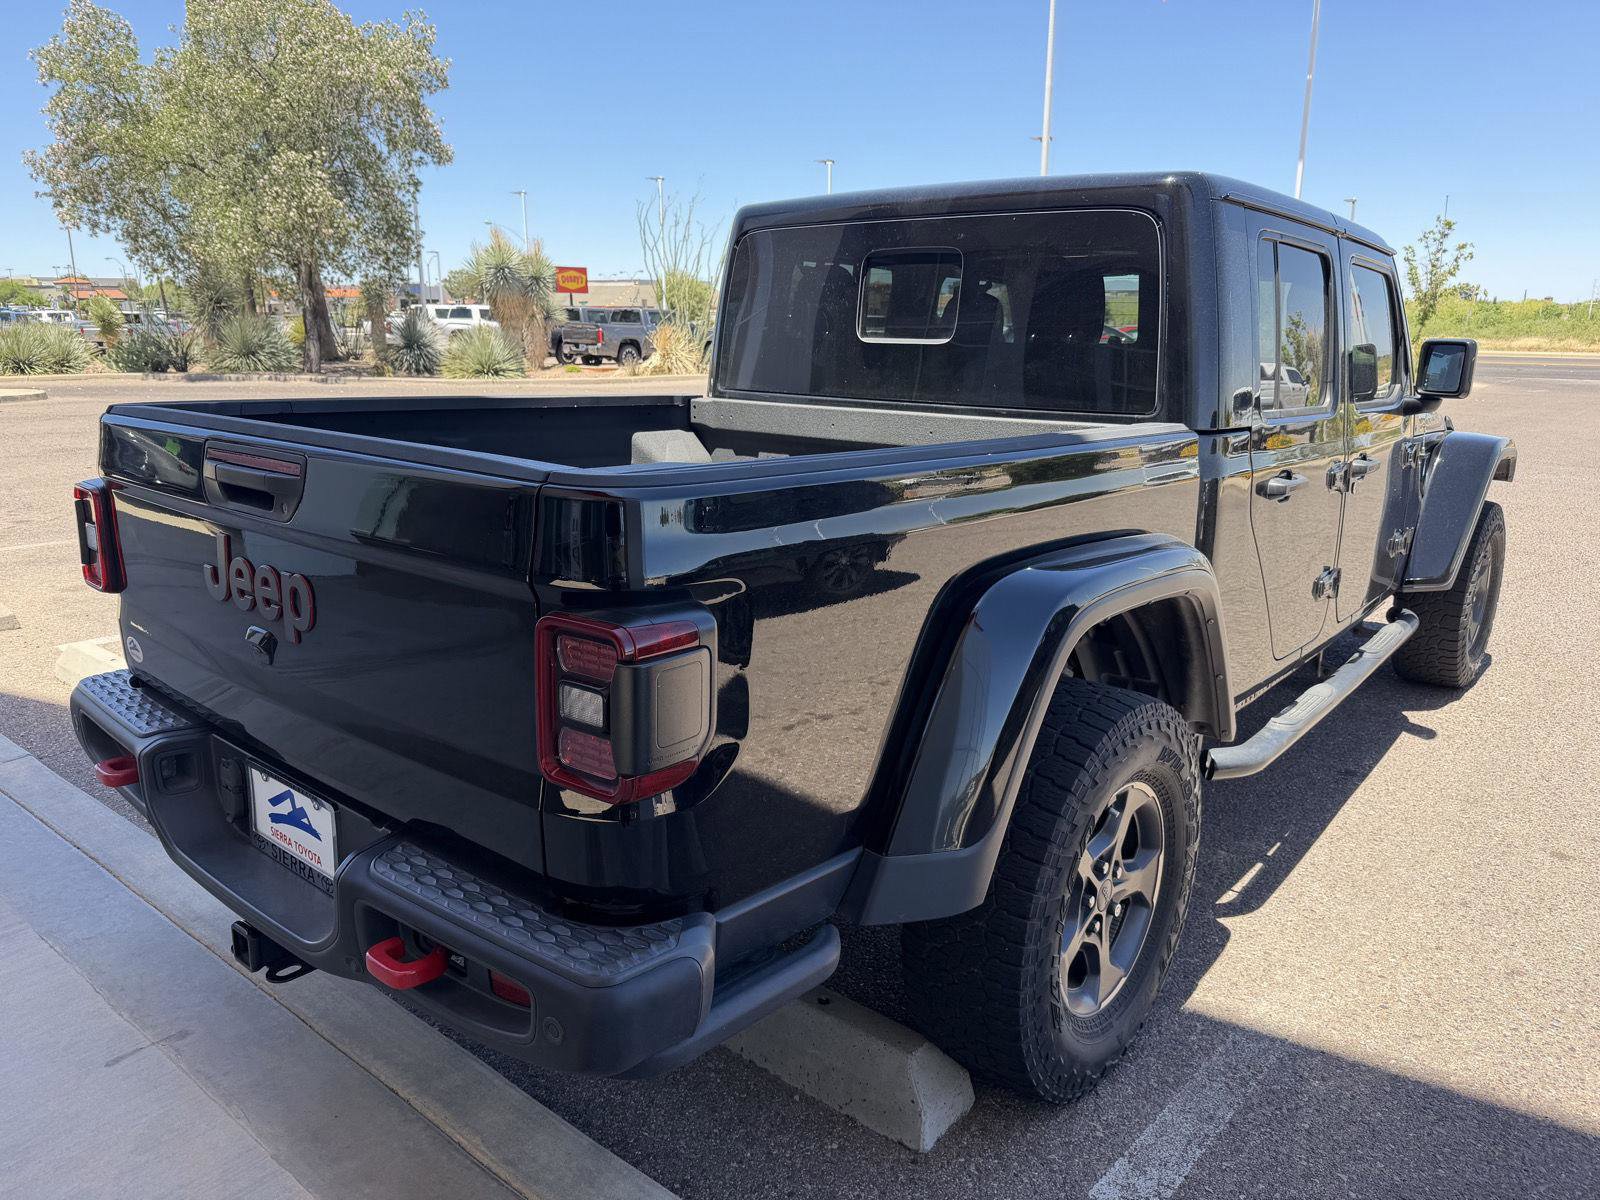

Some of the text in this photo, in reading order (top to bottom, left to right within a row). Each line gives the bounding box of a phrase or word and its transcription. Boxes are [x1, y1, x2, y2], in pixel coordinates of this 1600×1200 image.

[203, 530, 316, 646] Jeep
[270, 826, 323, 867] SIERRA TOYOTA
[271, 843, 315, 883] SIERRA
